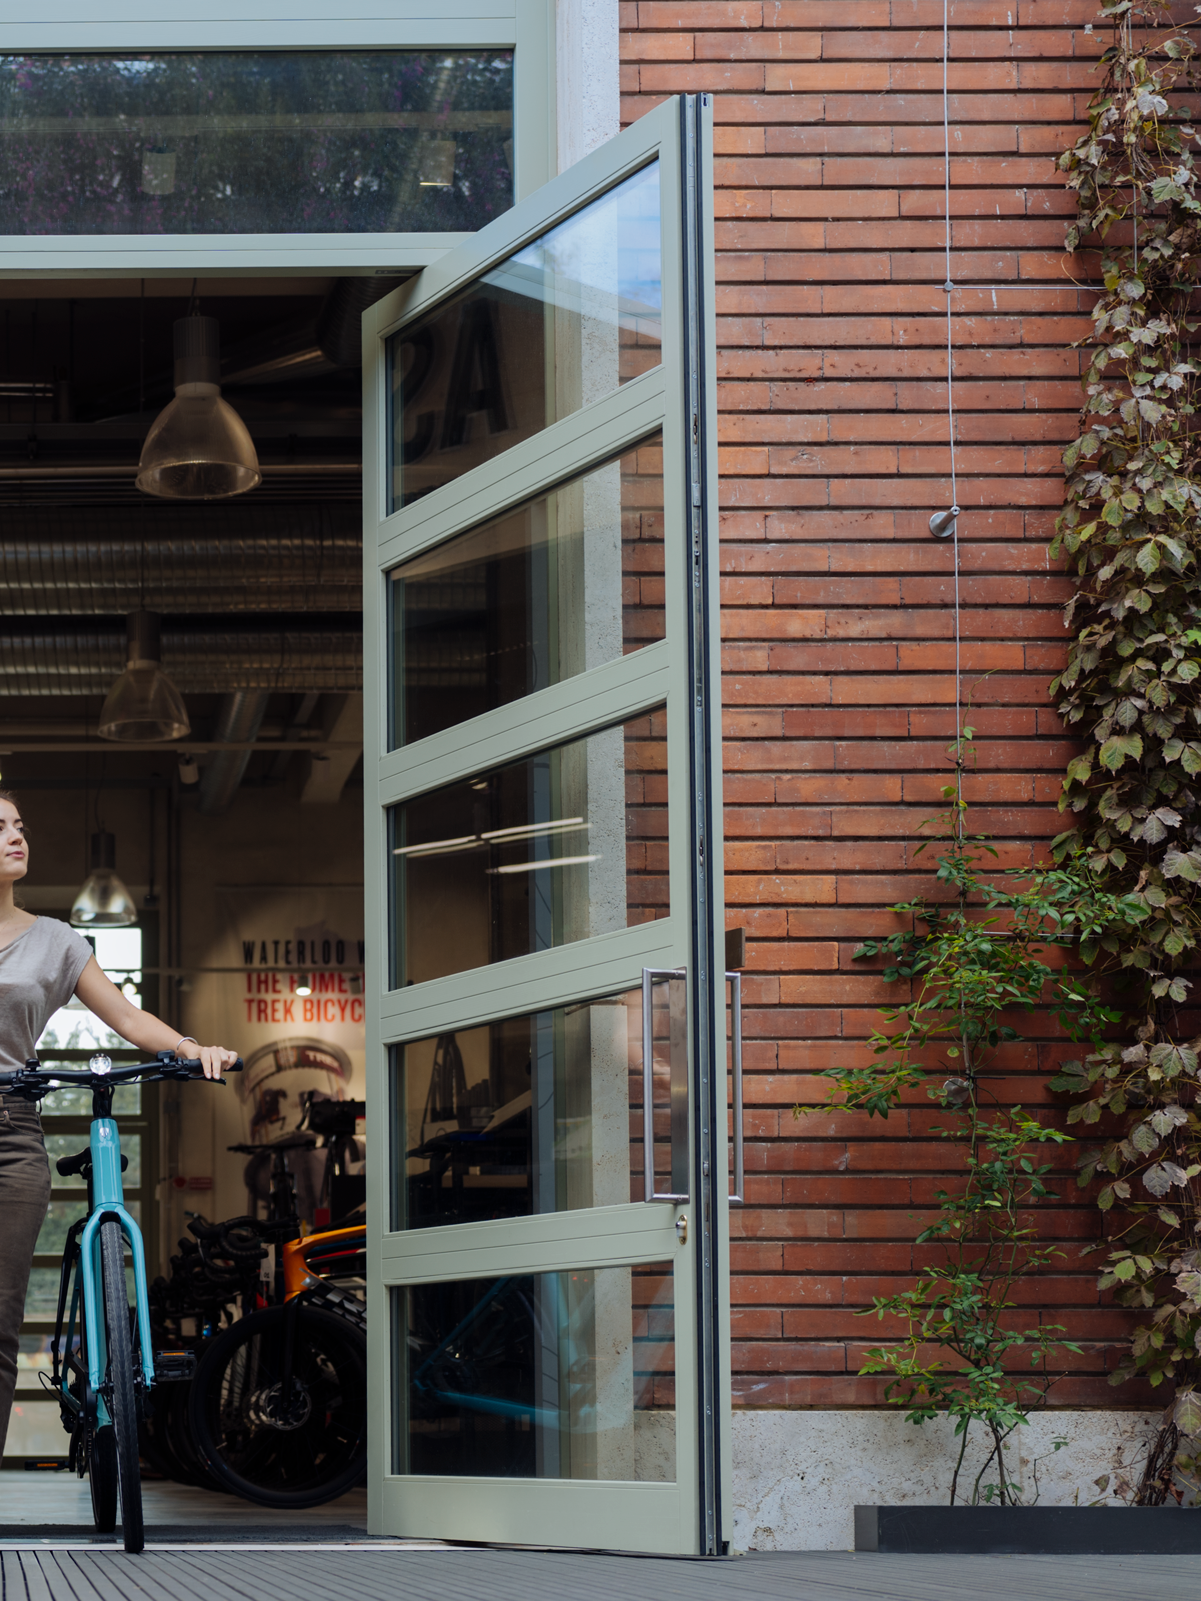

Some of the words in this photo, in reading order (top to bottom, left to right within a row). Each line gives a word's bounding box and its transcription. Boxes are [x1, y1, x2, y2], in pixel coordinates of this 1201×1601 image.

[243, 939, 345, 965] WATERLOO
[246, 972, 282, 994] THE
[243, 998, 295, 1023] TREK
[302, 998, 365, 1023] BICYC
